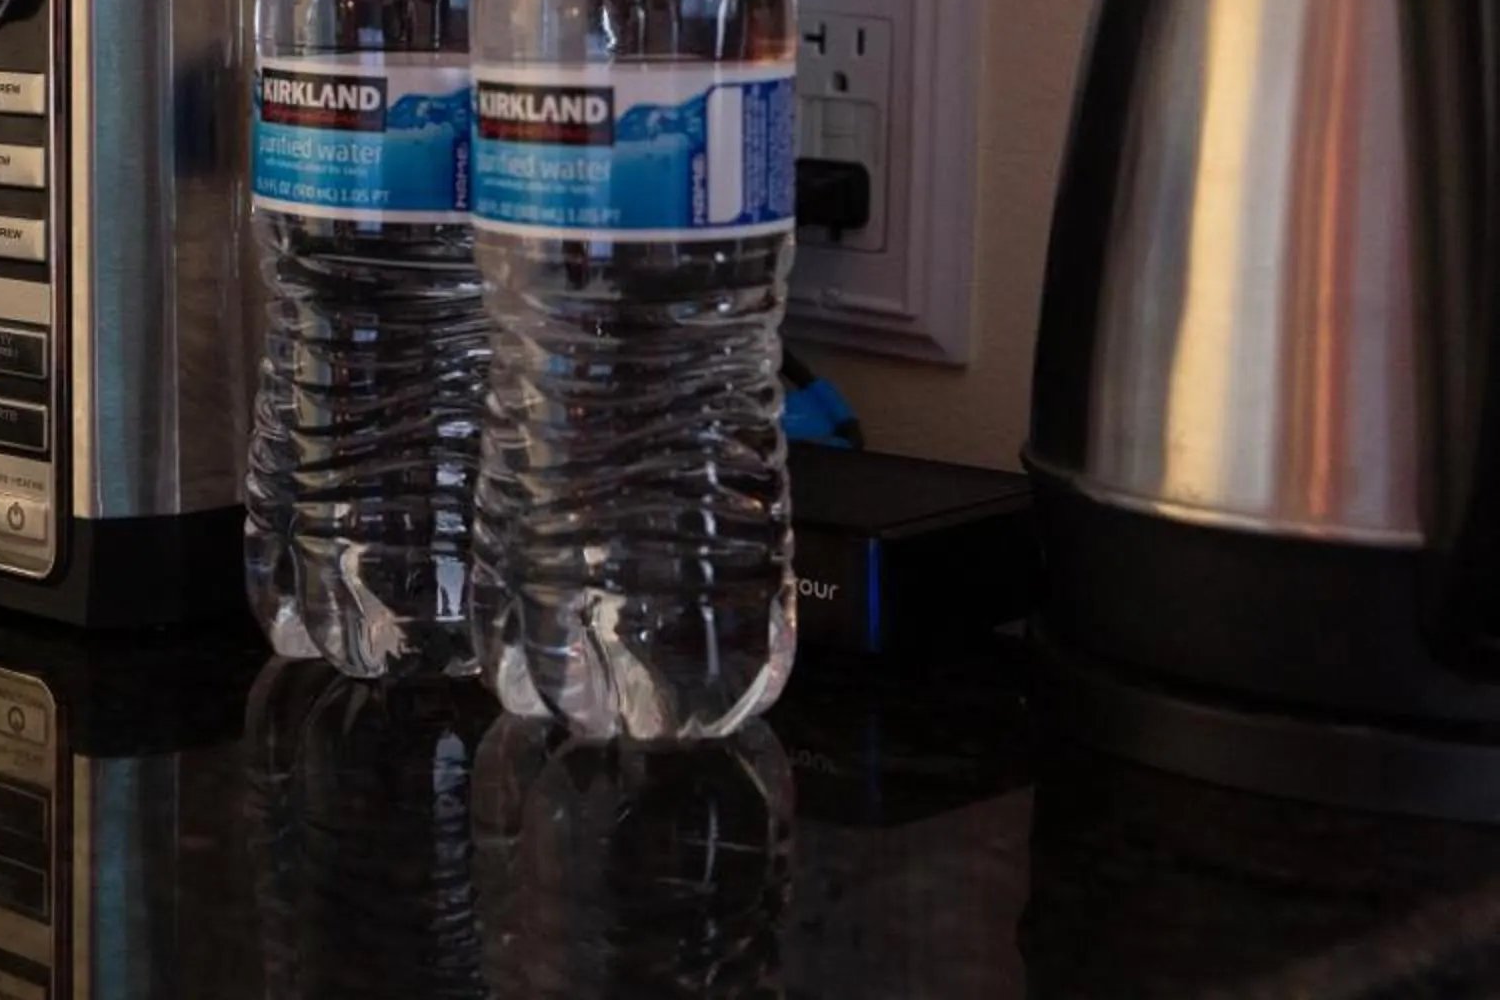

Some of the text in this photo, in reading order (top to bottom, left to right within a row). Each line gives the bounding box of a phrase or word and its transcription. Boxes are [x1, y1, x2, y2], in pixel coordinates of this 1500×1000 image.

[263, 76, 381, 111] KIRKLAND
[479, 89, 608, 124] KIRKLAND
[317, 143, 383, 165] water
[795, 577, 840, 600] our
